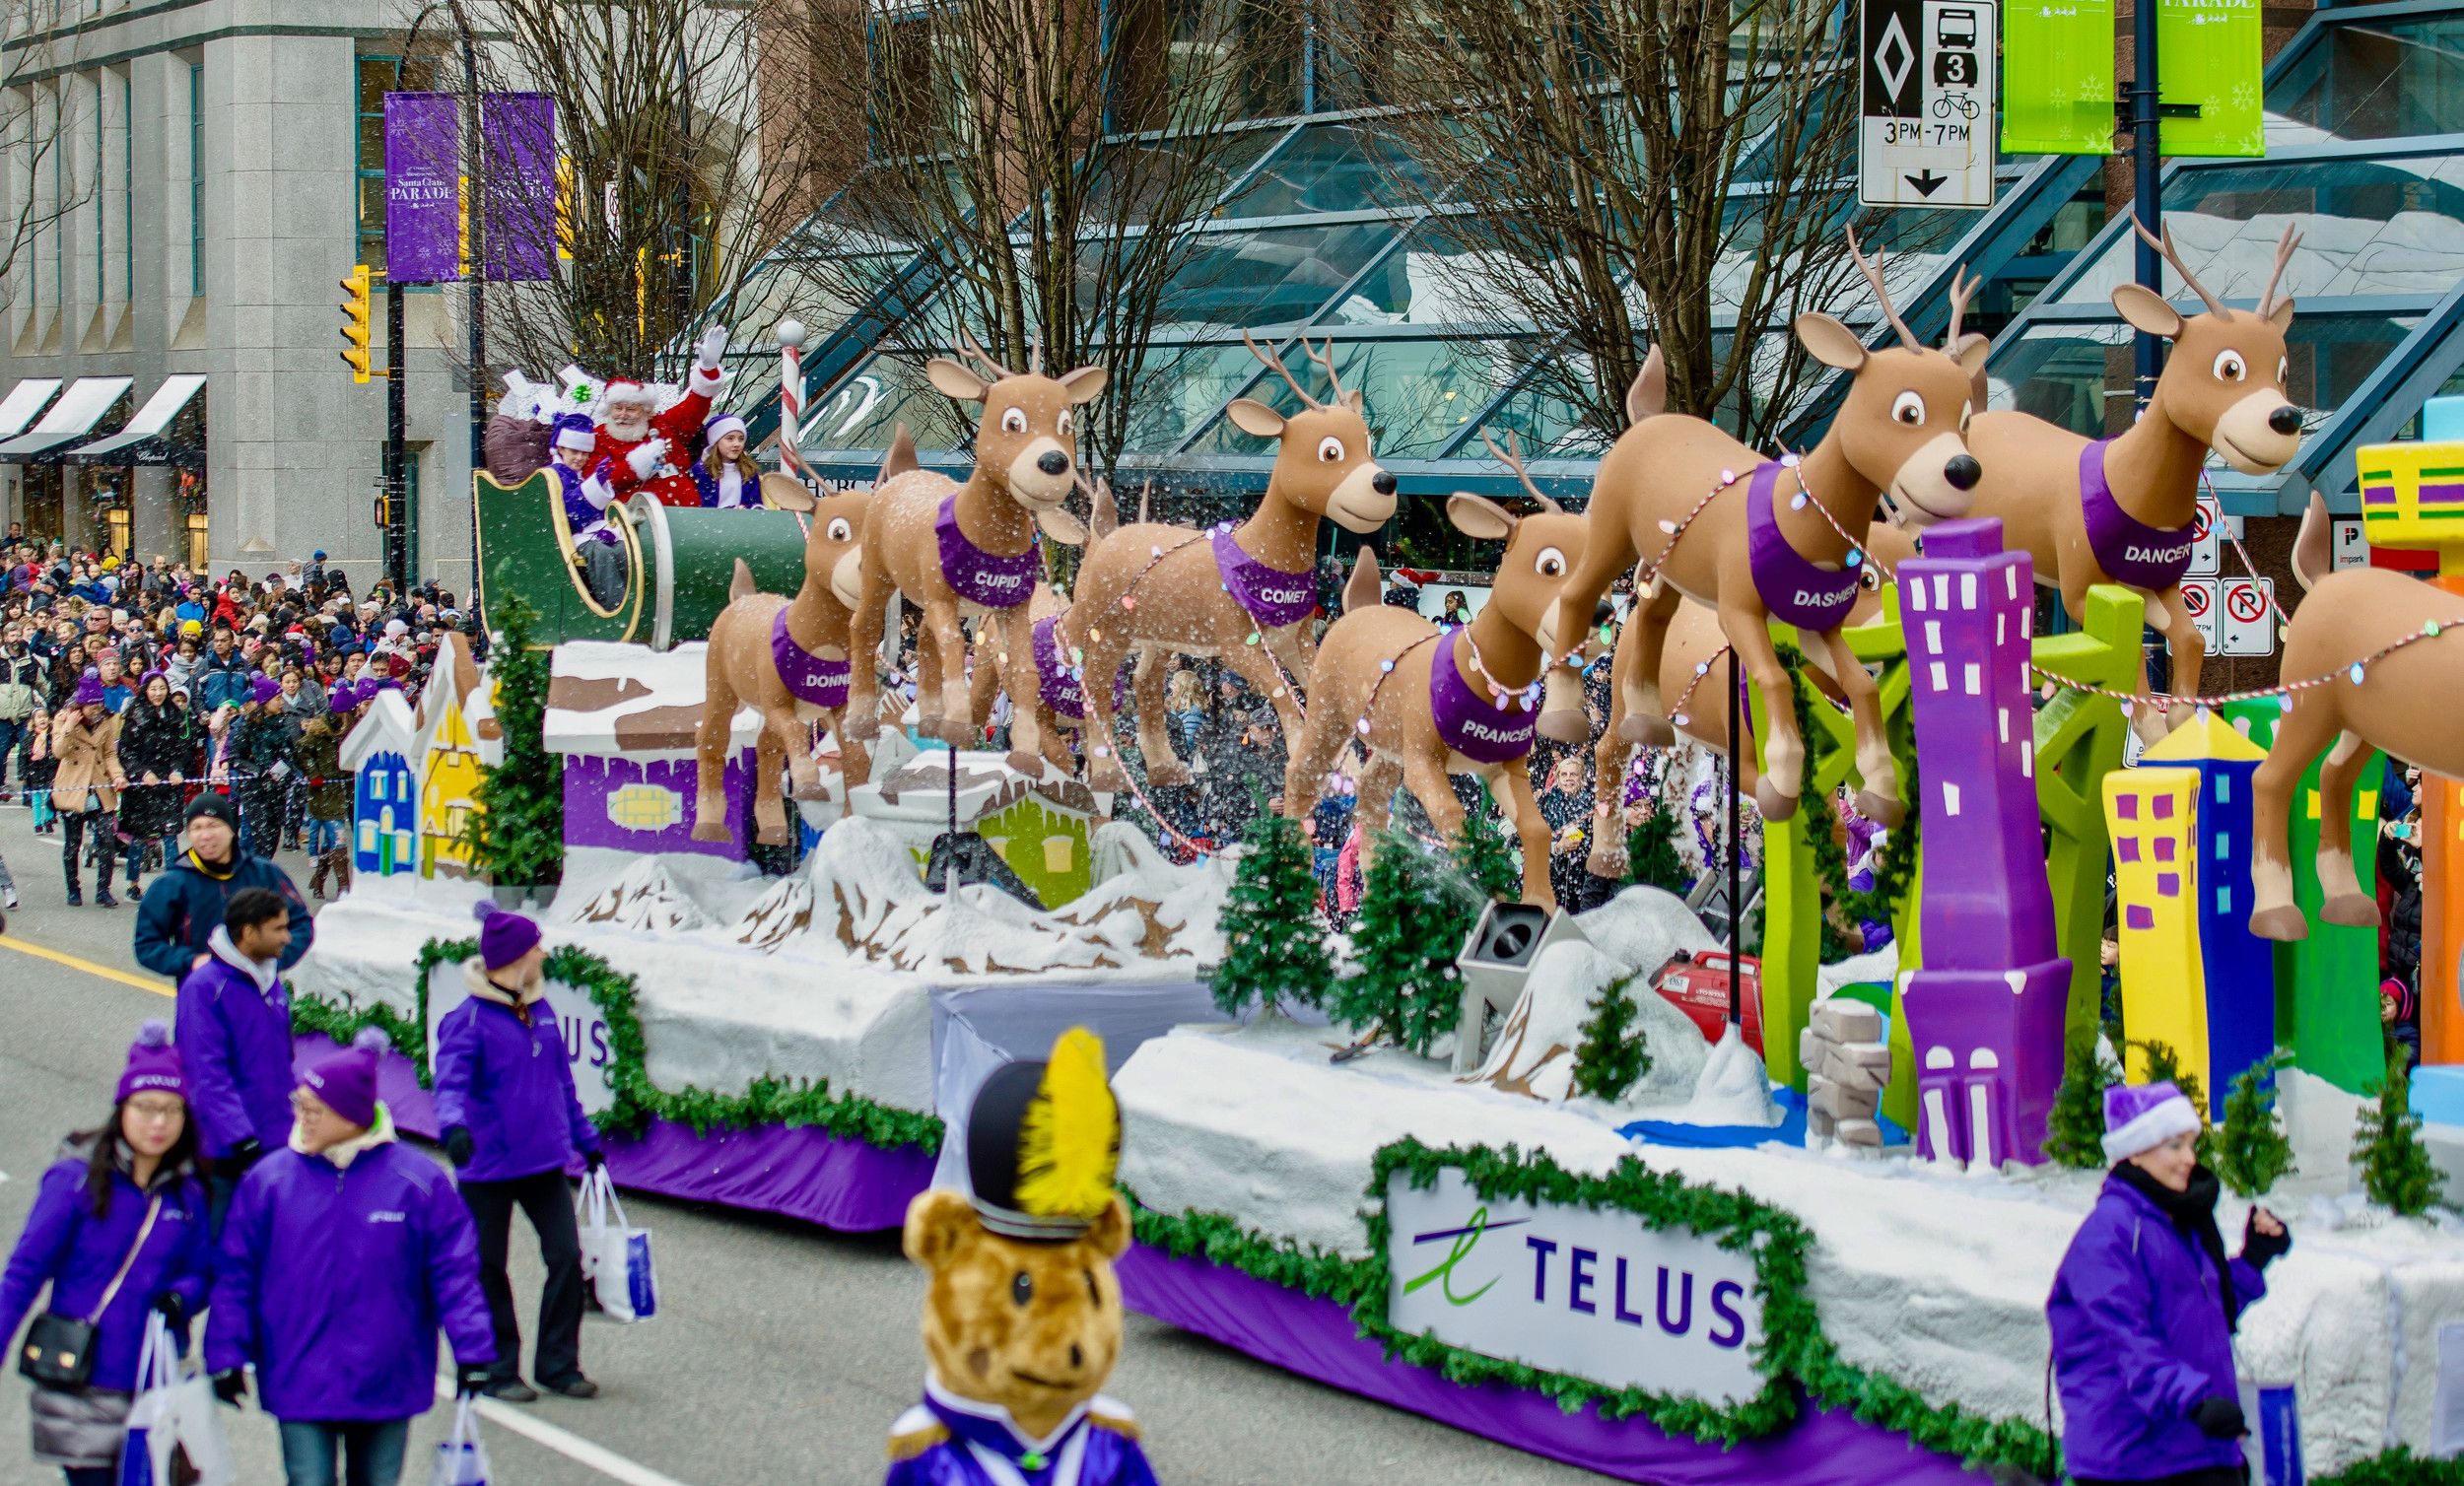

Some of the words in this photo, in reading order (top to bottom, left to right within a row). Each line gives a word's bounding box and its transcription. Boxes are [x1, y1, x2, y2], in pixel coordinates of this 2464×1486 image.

[390, 187, 453, 200] PARADE
[2124, 542, 2191, 564] DANCER
[2340, 555, 2363, 565] impark
[975, 572, 1021, 588] CUPID
[1262, 588, 1308, 604] COMET
[1793, 581, 1858, 607] DASHER
[806, 672, 853, 688] DONNE
[1462, 719, 1533, 743] PRANCER
[1526, 1235, 1745, 1349] TELUS
